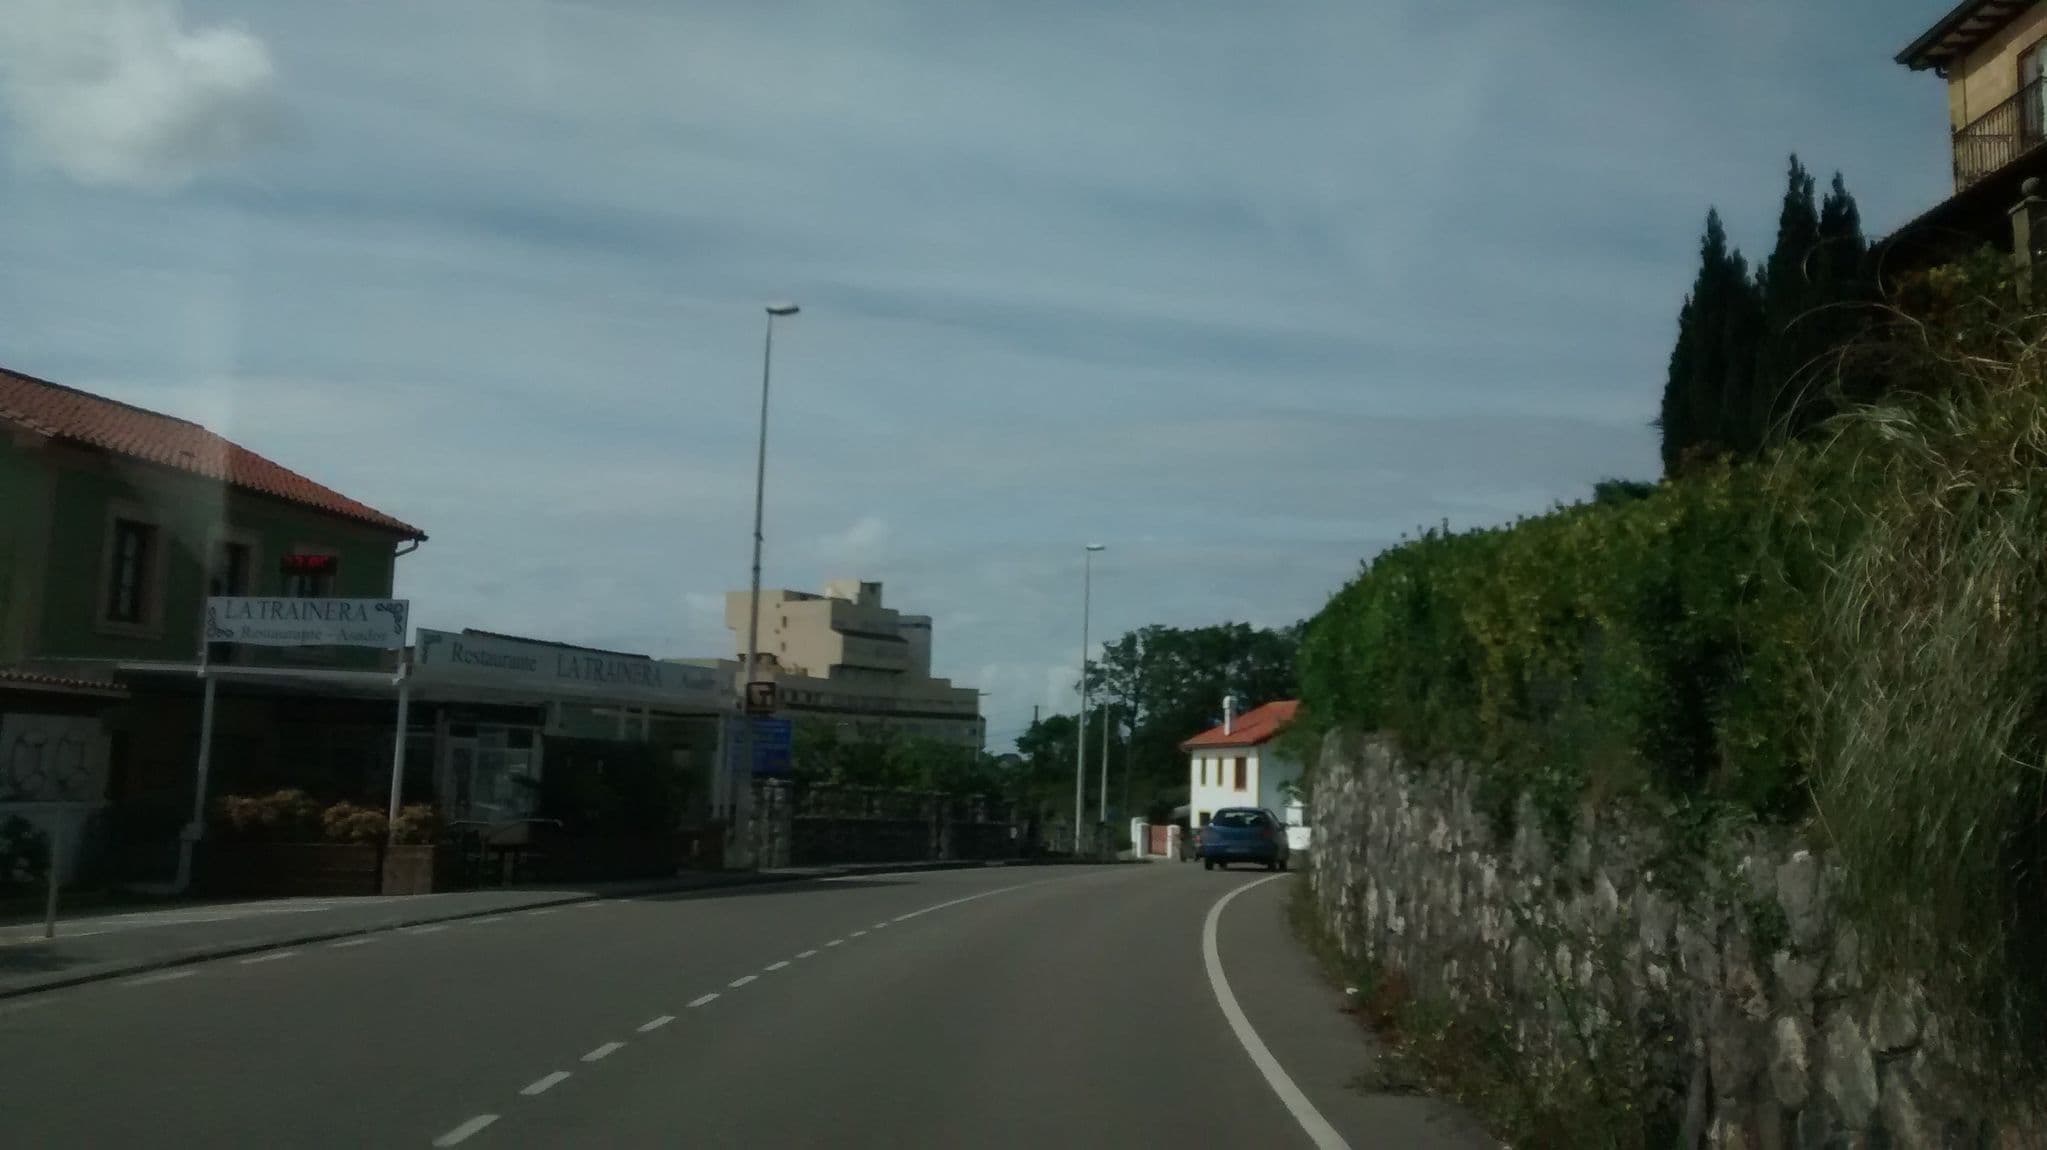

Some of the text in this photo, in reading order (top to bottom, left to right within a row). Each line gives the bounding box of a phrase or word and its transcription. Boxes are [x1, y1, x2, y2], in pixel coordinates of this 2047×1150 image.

[224, 600, 369, 622] LA TRAINERA
[451, 641, 537, 672] Restaurante
[556, 653, 580, 680] LA
[582, 656, 663, 688] TRAINERA
